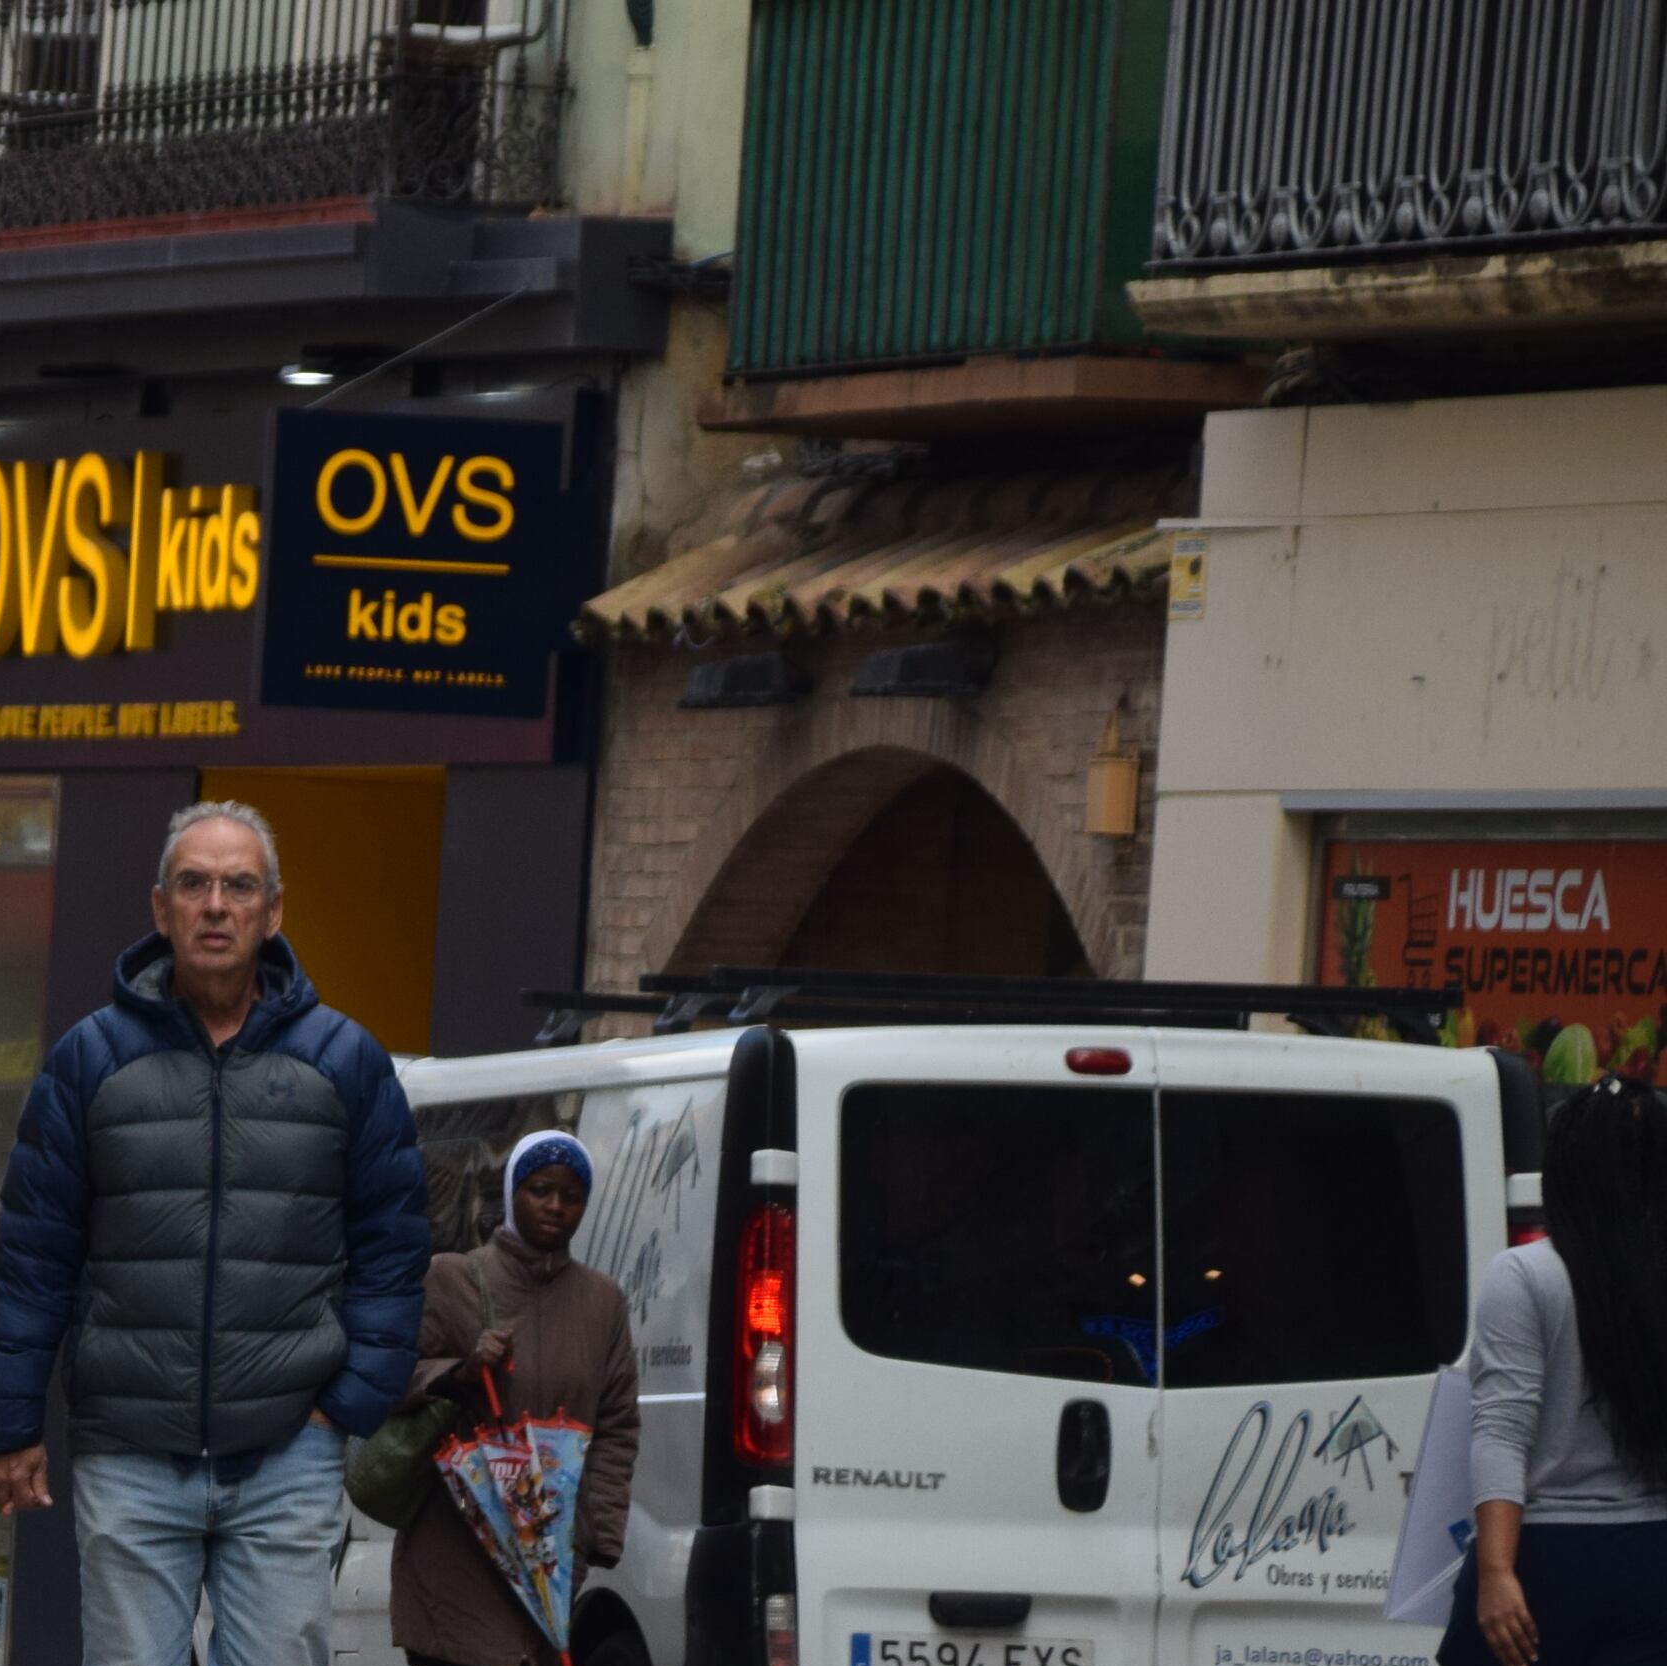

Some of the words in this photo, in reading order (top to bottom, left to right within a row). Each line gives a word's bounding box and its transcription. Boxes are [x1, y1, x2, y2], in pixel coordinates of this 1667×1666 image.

[316, 448, 515, 543] OVS
[157, 484, 261, 611] kids
[347, 588, 467, 646] kids
[1447, 868, 1611, 931] HUESCA
[813, 1467, 946, 1490] RENAULT
[1267, 1564, 1314, 1588] Obras
[1321, 1571, 1330, 1593] y
